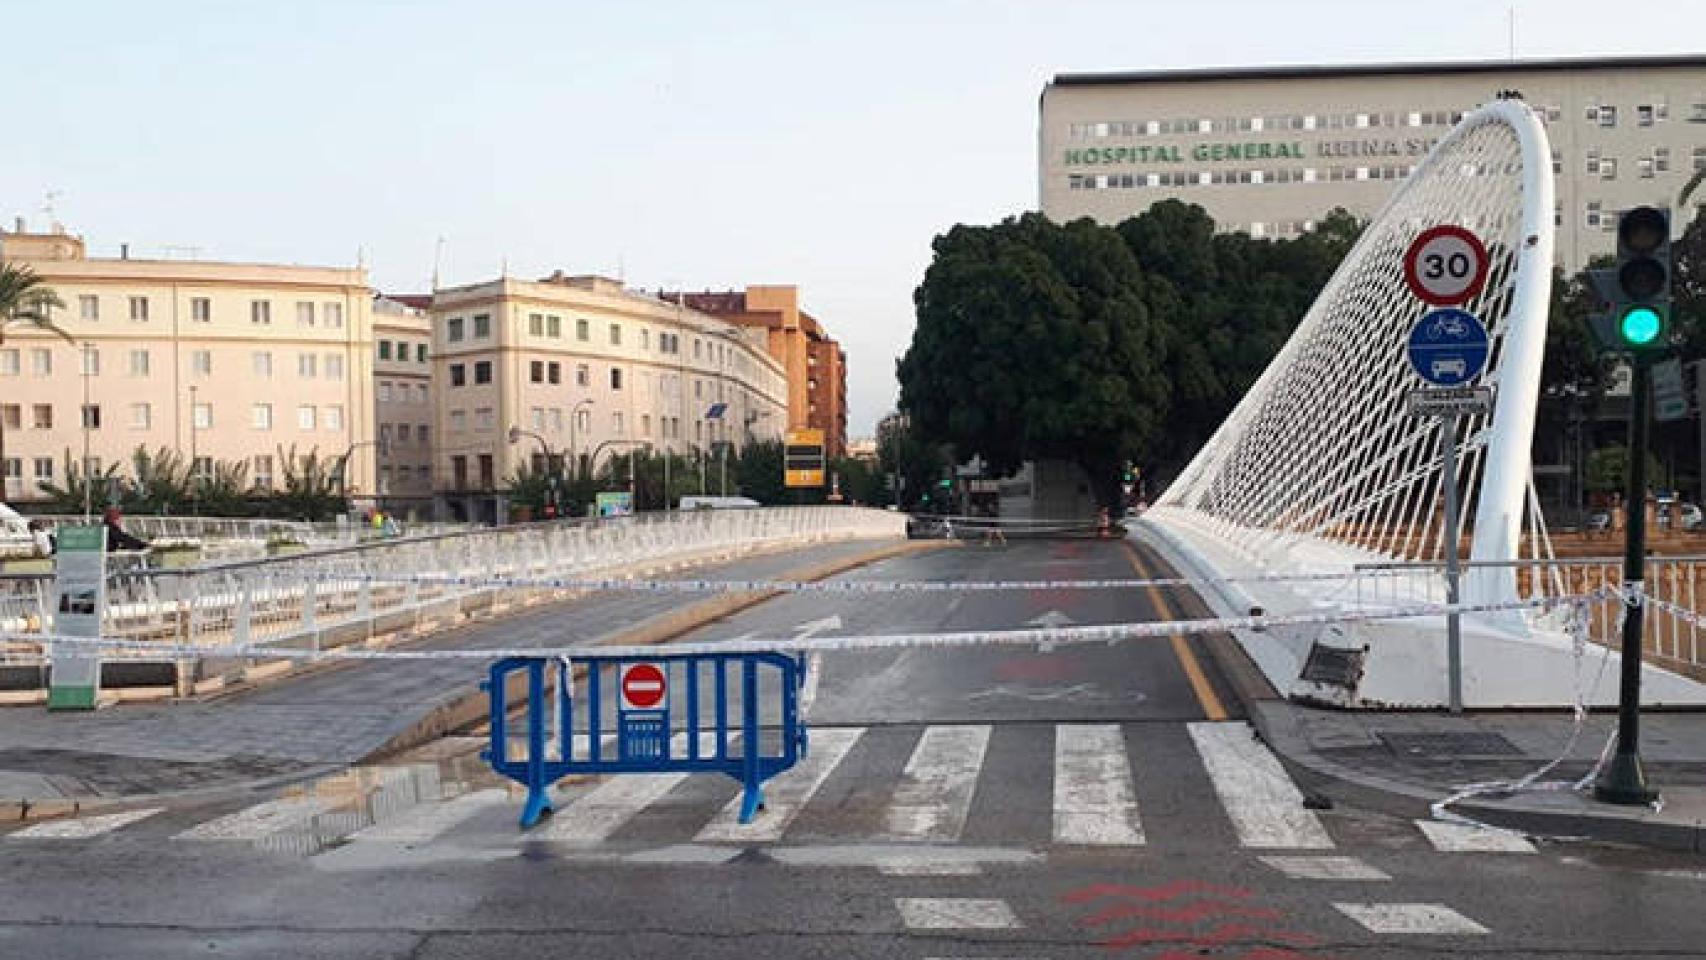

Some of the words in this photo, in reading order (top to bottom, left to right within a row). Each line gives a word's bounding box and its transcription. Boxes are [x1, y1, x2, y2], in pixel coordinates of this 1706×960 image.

[1065, 145, 1185, 165] HOSPITAL
[1192, 142, 1304, 161] GENERAL
[1424, 252, 1469, 279] 30
